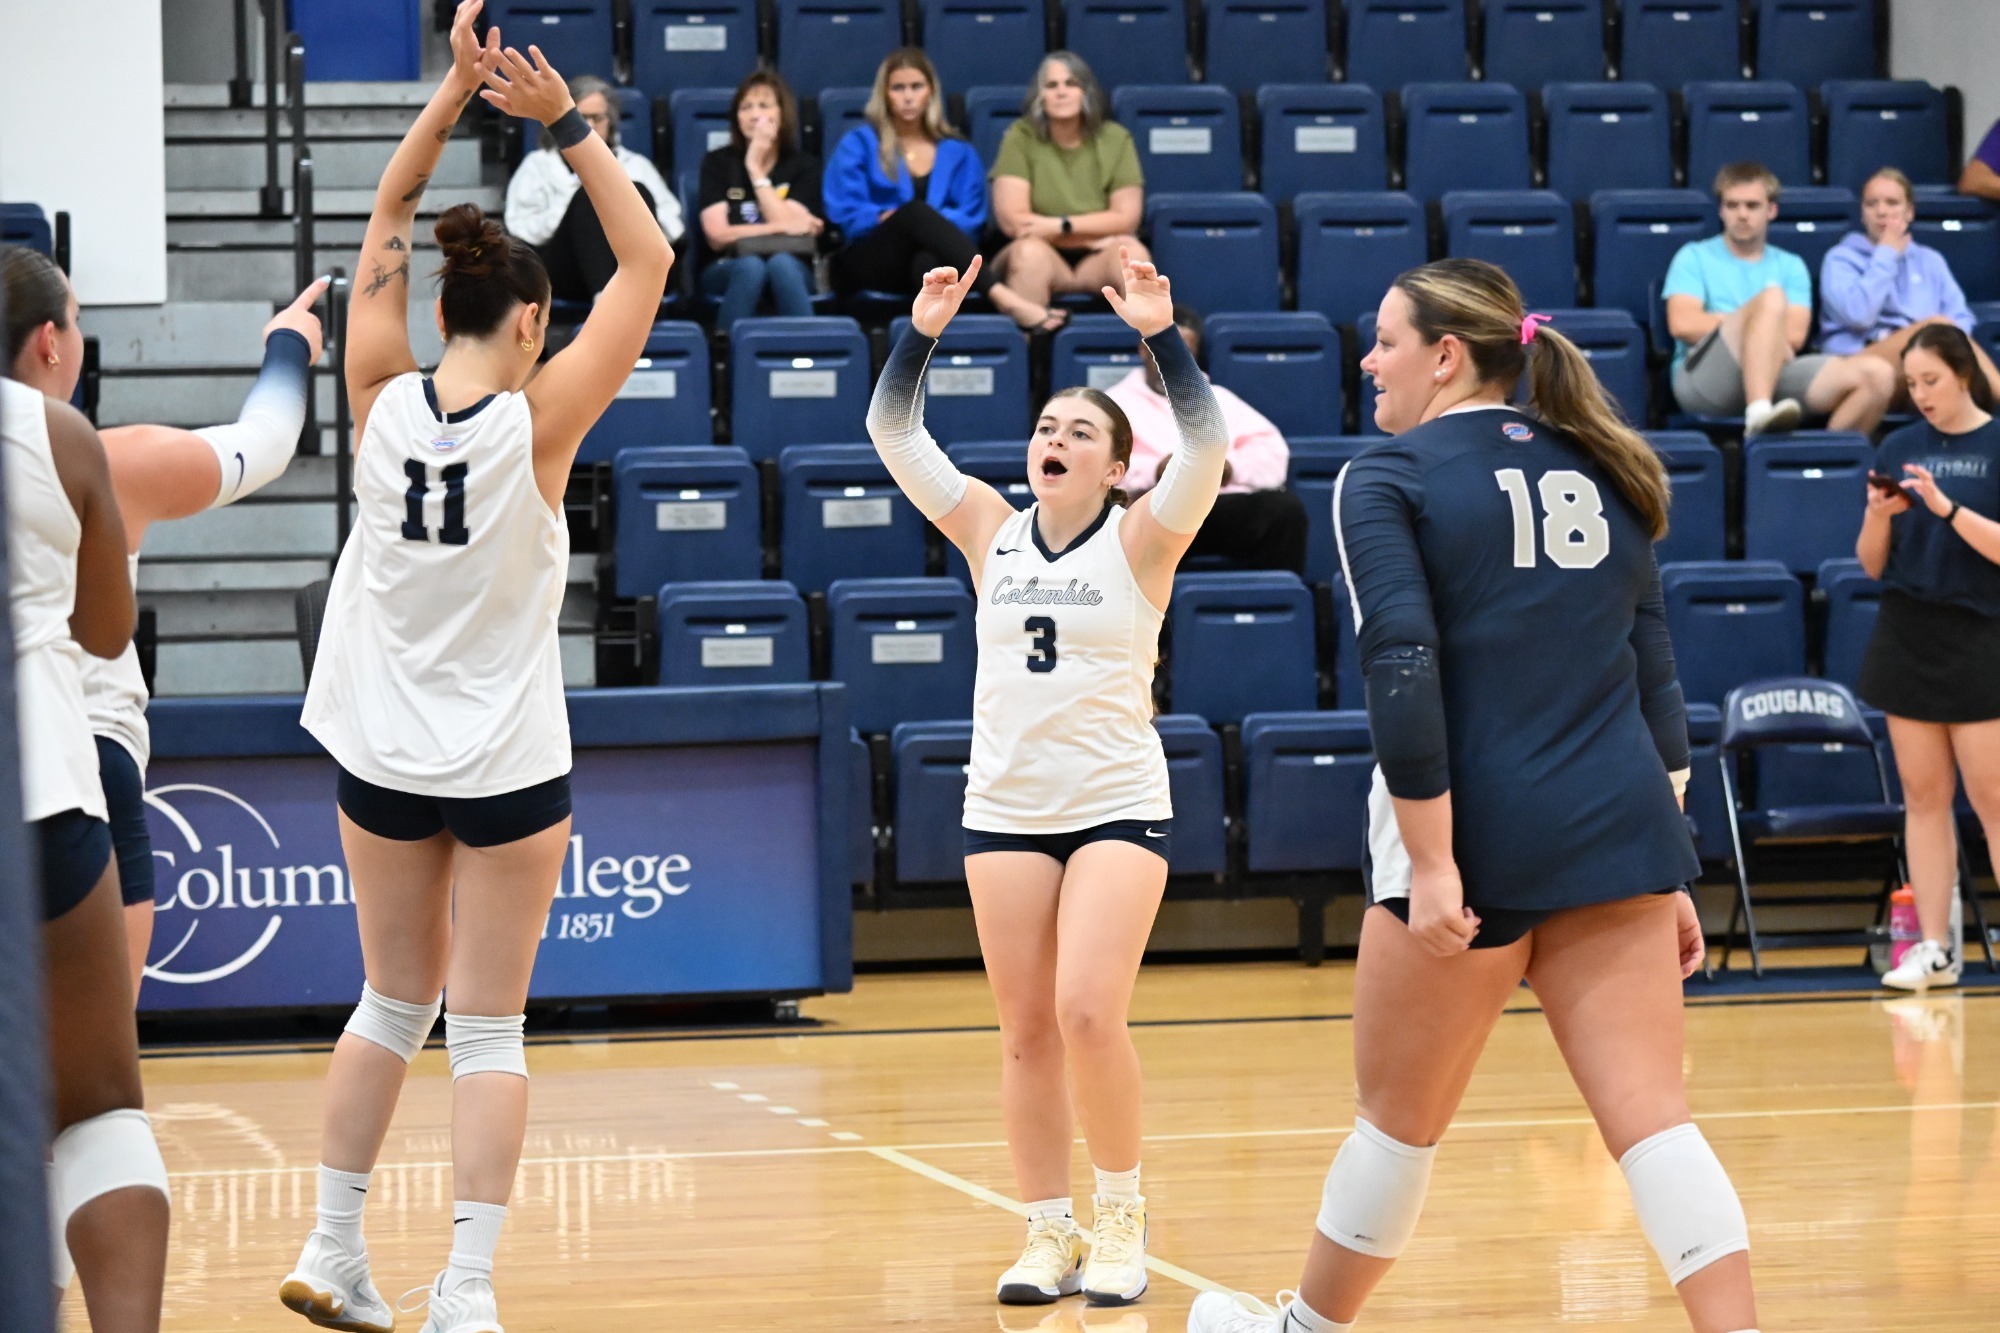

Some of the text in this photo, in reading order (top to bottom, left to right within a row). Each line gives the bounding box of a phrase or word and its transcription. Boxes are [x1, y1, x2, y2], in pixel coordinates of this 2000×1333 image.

[401, 457, 470, 546] 11
[1494, 468, 1610, 569] 18
[991, 576, 1104, 606] Columbia
[1023, 615, 1058, 674] 3
[1741, 688, 1844, 721] COUGARS
[151, 843, 356, 912] Colum
[557, 912, 615, 943] 1851
